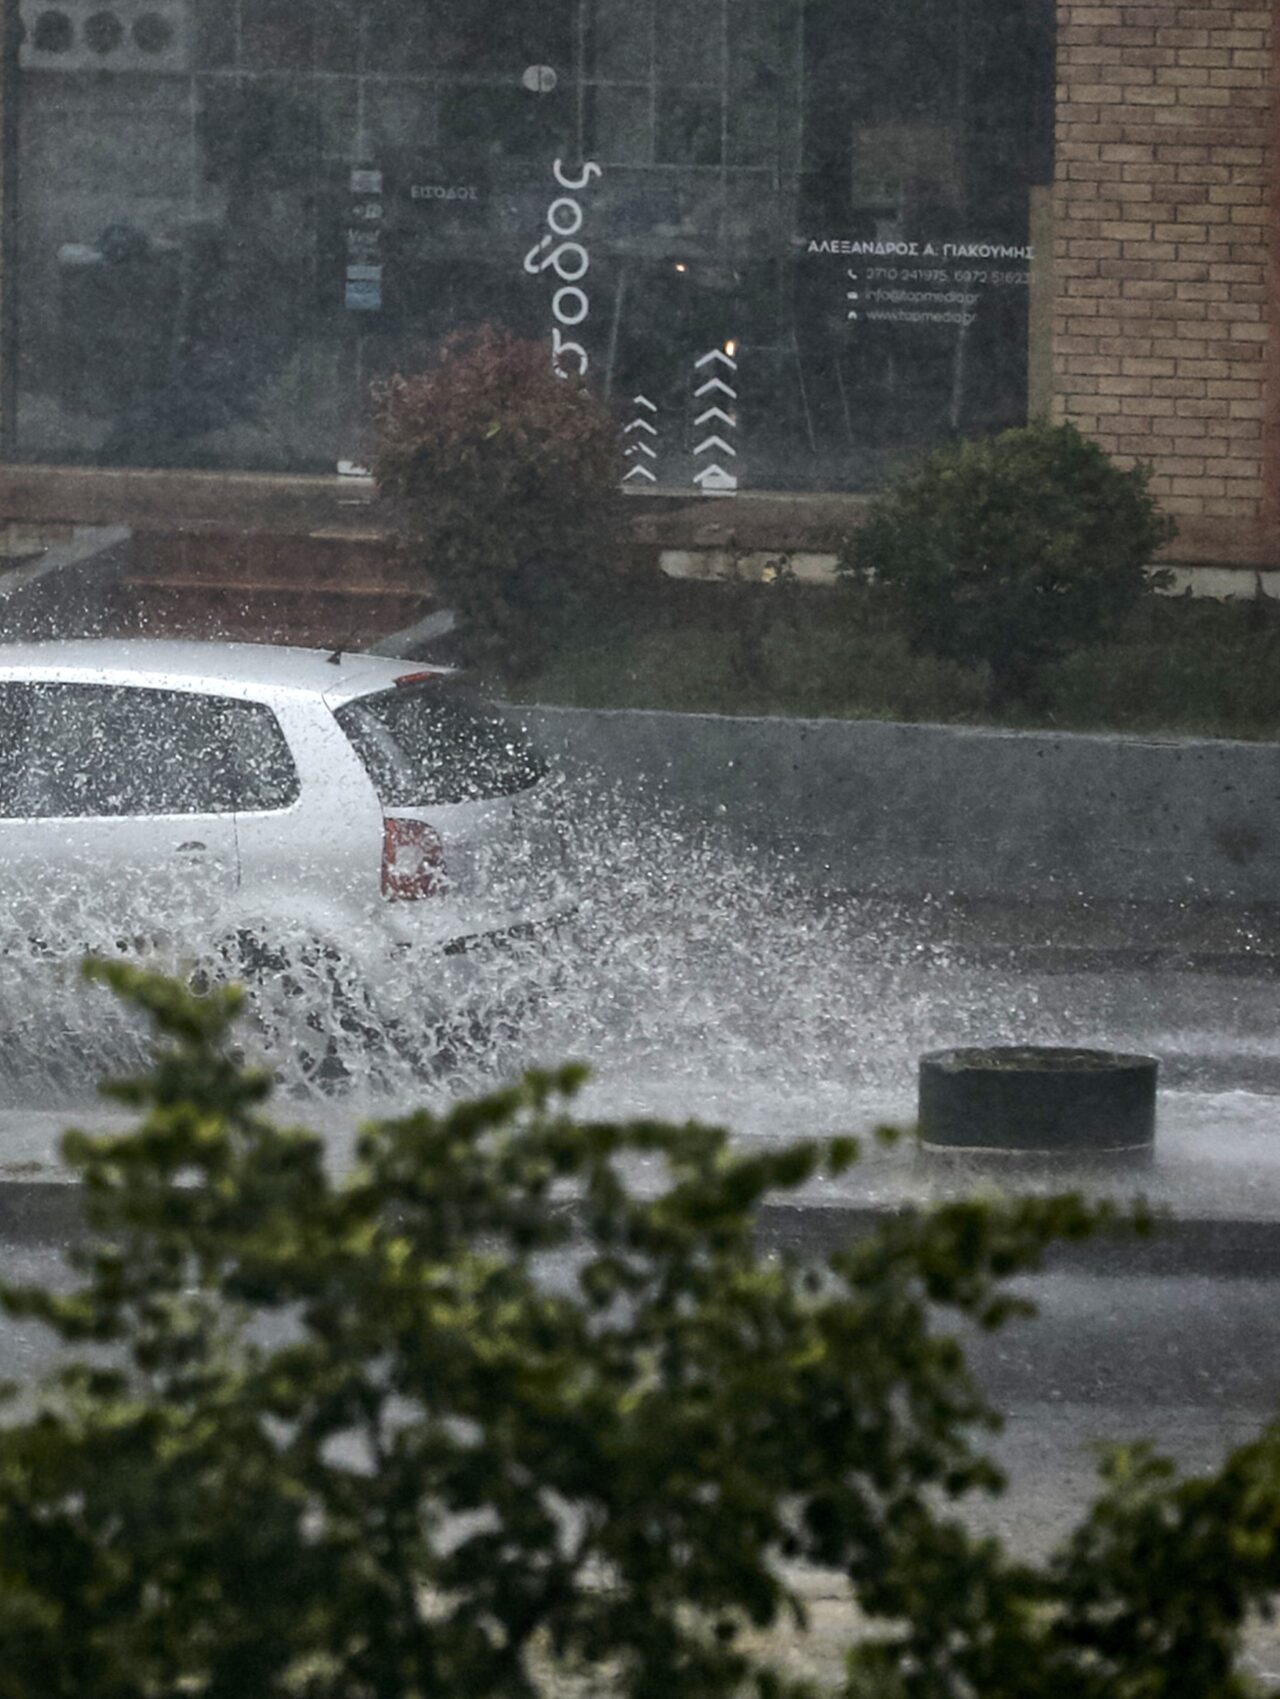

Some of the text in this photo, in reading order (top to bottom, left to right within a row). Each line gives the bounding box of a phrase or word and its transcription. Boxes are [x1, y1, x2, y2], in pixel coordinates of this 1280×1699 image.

[410, 184, 479, 200] ΕΙΣΟΔΟΣ
[807, 240, 919, 256] ΑΛΕΞΑΝΔΡΟΣ
[942, 243, 1036, 260] ΓΙΑΚΟΥΜΗΣ
[523, 157, 603, 380] σοδος
